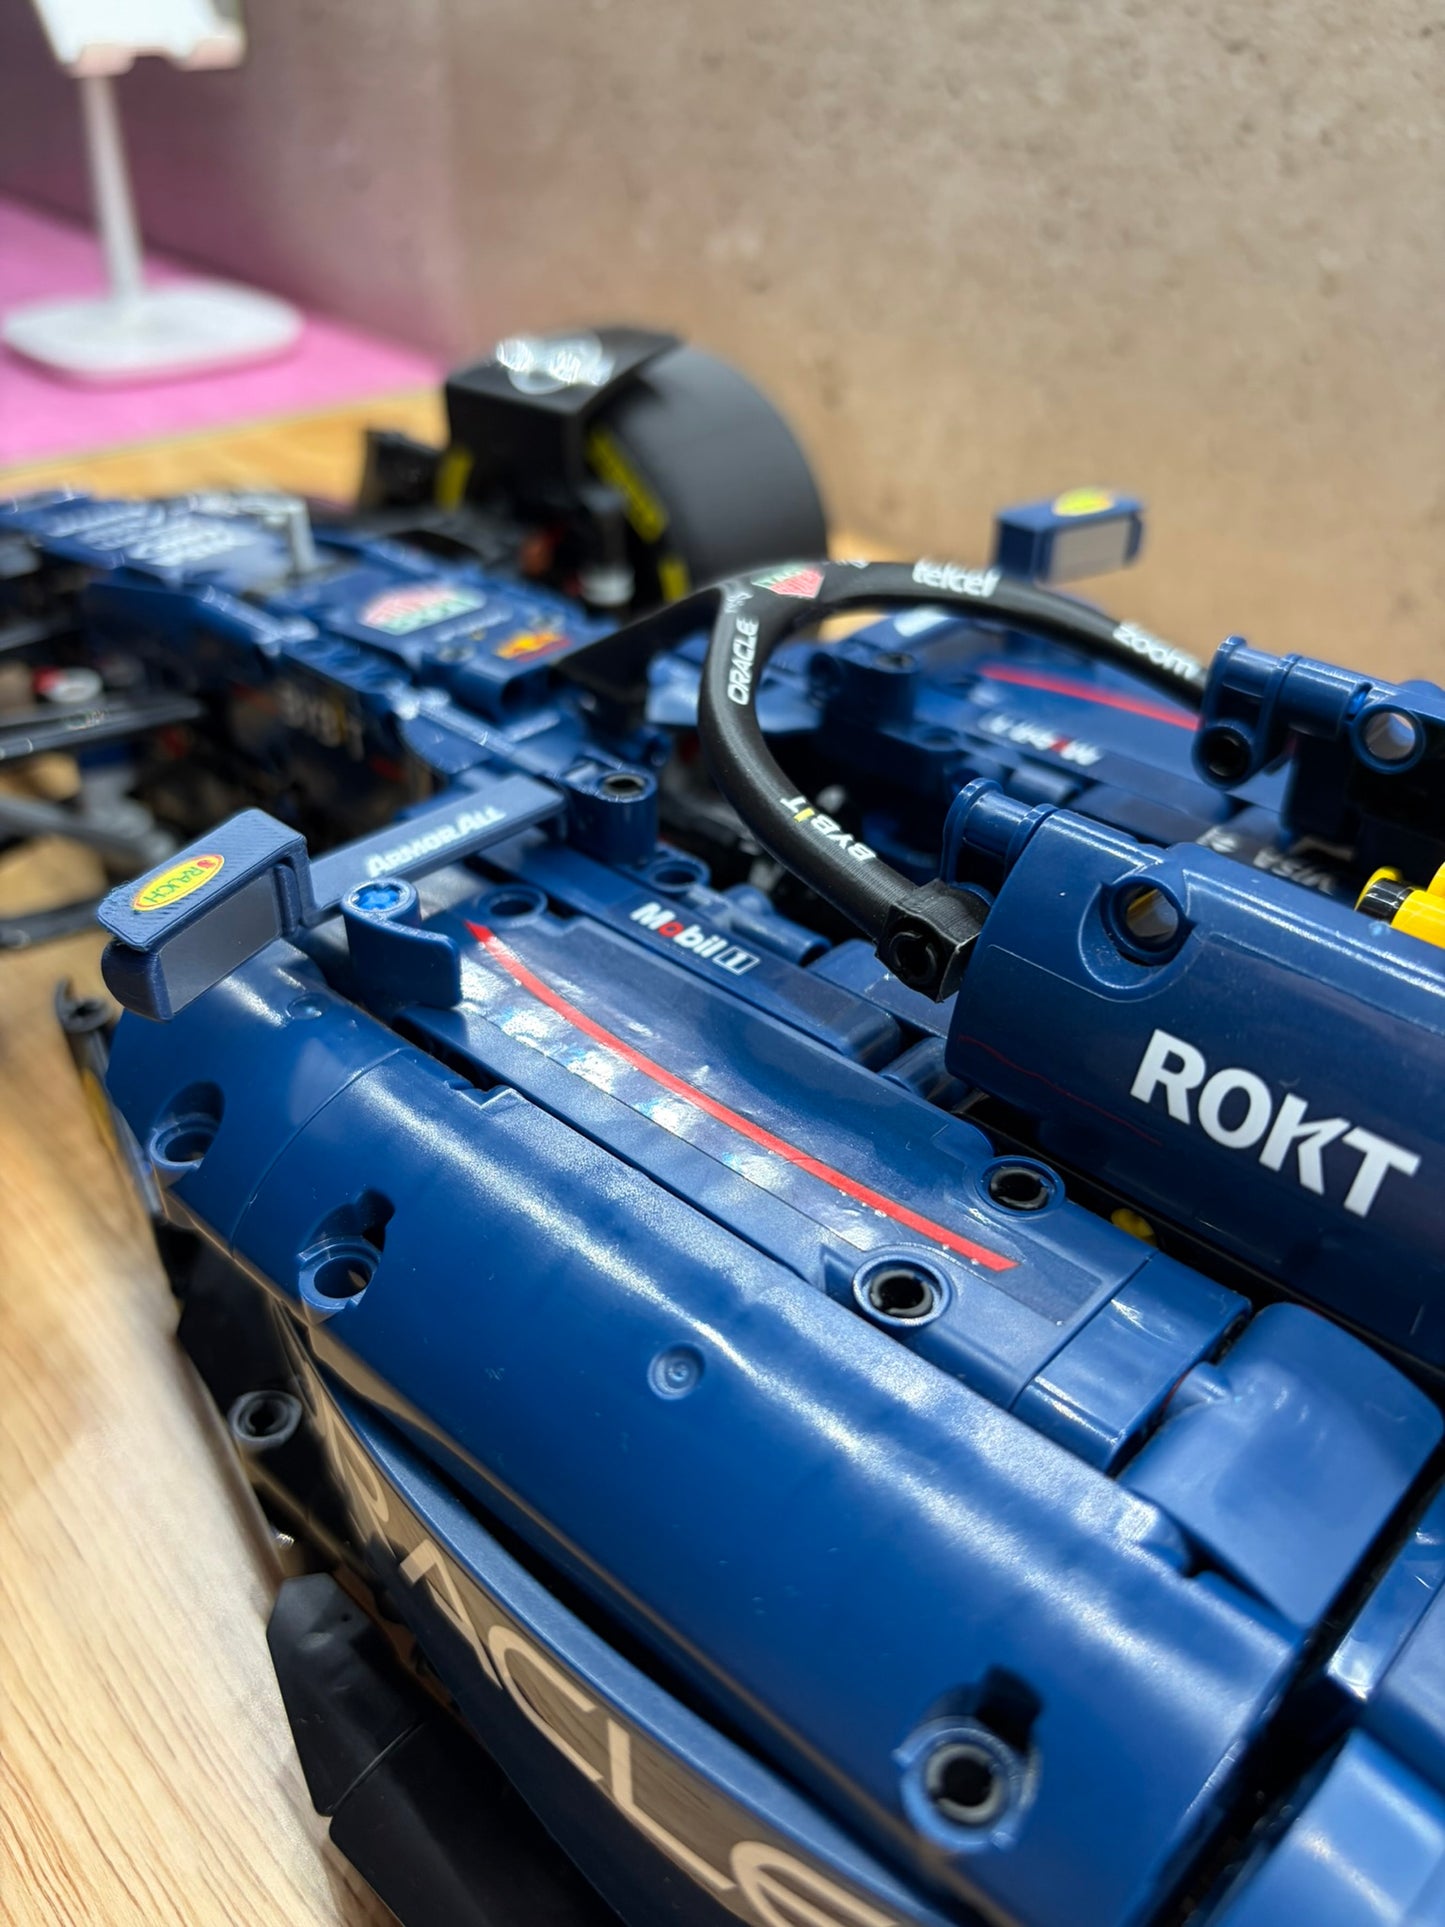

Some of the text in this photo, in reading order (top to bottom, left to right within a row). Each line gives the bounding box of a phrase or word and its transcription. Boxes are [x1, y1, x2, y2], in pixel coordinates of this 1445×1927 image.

[911, 559, 1000, 597] telcel
[727, 615, 759, 705] ORACLE
[1113, 620, 1199, 680] zoom
[780, 796, 877, 861] BYBIT
[143, 866, 204, 904] RAUCH
[629, 901, 728, 958] Mobil
[1130, 1028, 1421, 1218] ROKT
